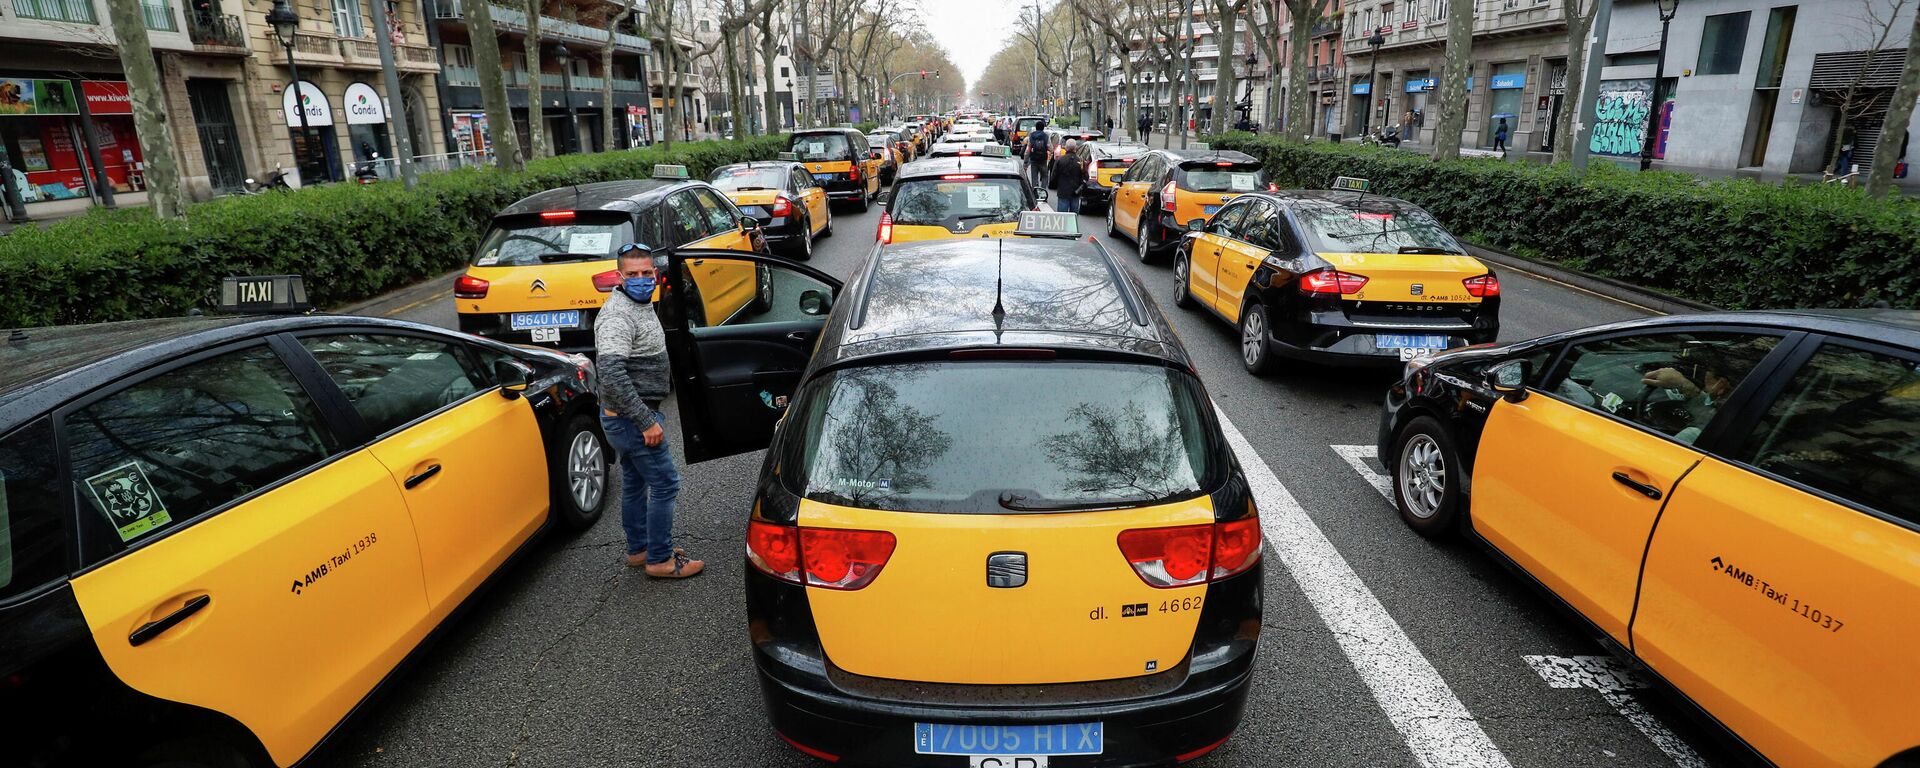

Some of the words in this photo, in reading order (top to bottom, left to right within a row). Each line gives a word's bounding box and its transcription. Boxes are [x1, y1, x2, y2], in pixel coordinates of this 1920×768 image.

[293, 104, 322, 116] Cndis
[352, 103, 377, 115] Condis
[1348, 179, 1363, 189] TAXI
[1040, 212, 1065, 230] TAXI
[239, 281, 272, 303] TAXI
[518, 314, 548, 325] 9640
[552, 313, 574, 324] KPV
[535, 328, 556, 341] SP
[838, 478, 876, 488] M-Motor
[304, 563, 328, 587] AMB
[331, 548, 351, 568] Taxi
[353, 532, 377, 555] 1938
[1724, 564, 1754, 587] AMB
[1760, 581, 1788, 605] Taxi
[1791, 599, 1844, 633] 11037
[1089, 606, 1108, 620] dl.
[1159, 596, 1202, 614] 4662
[938, 724, 1020, 750] 7005
